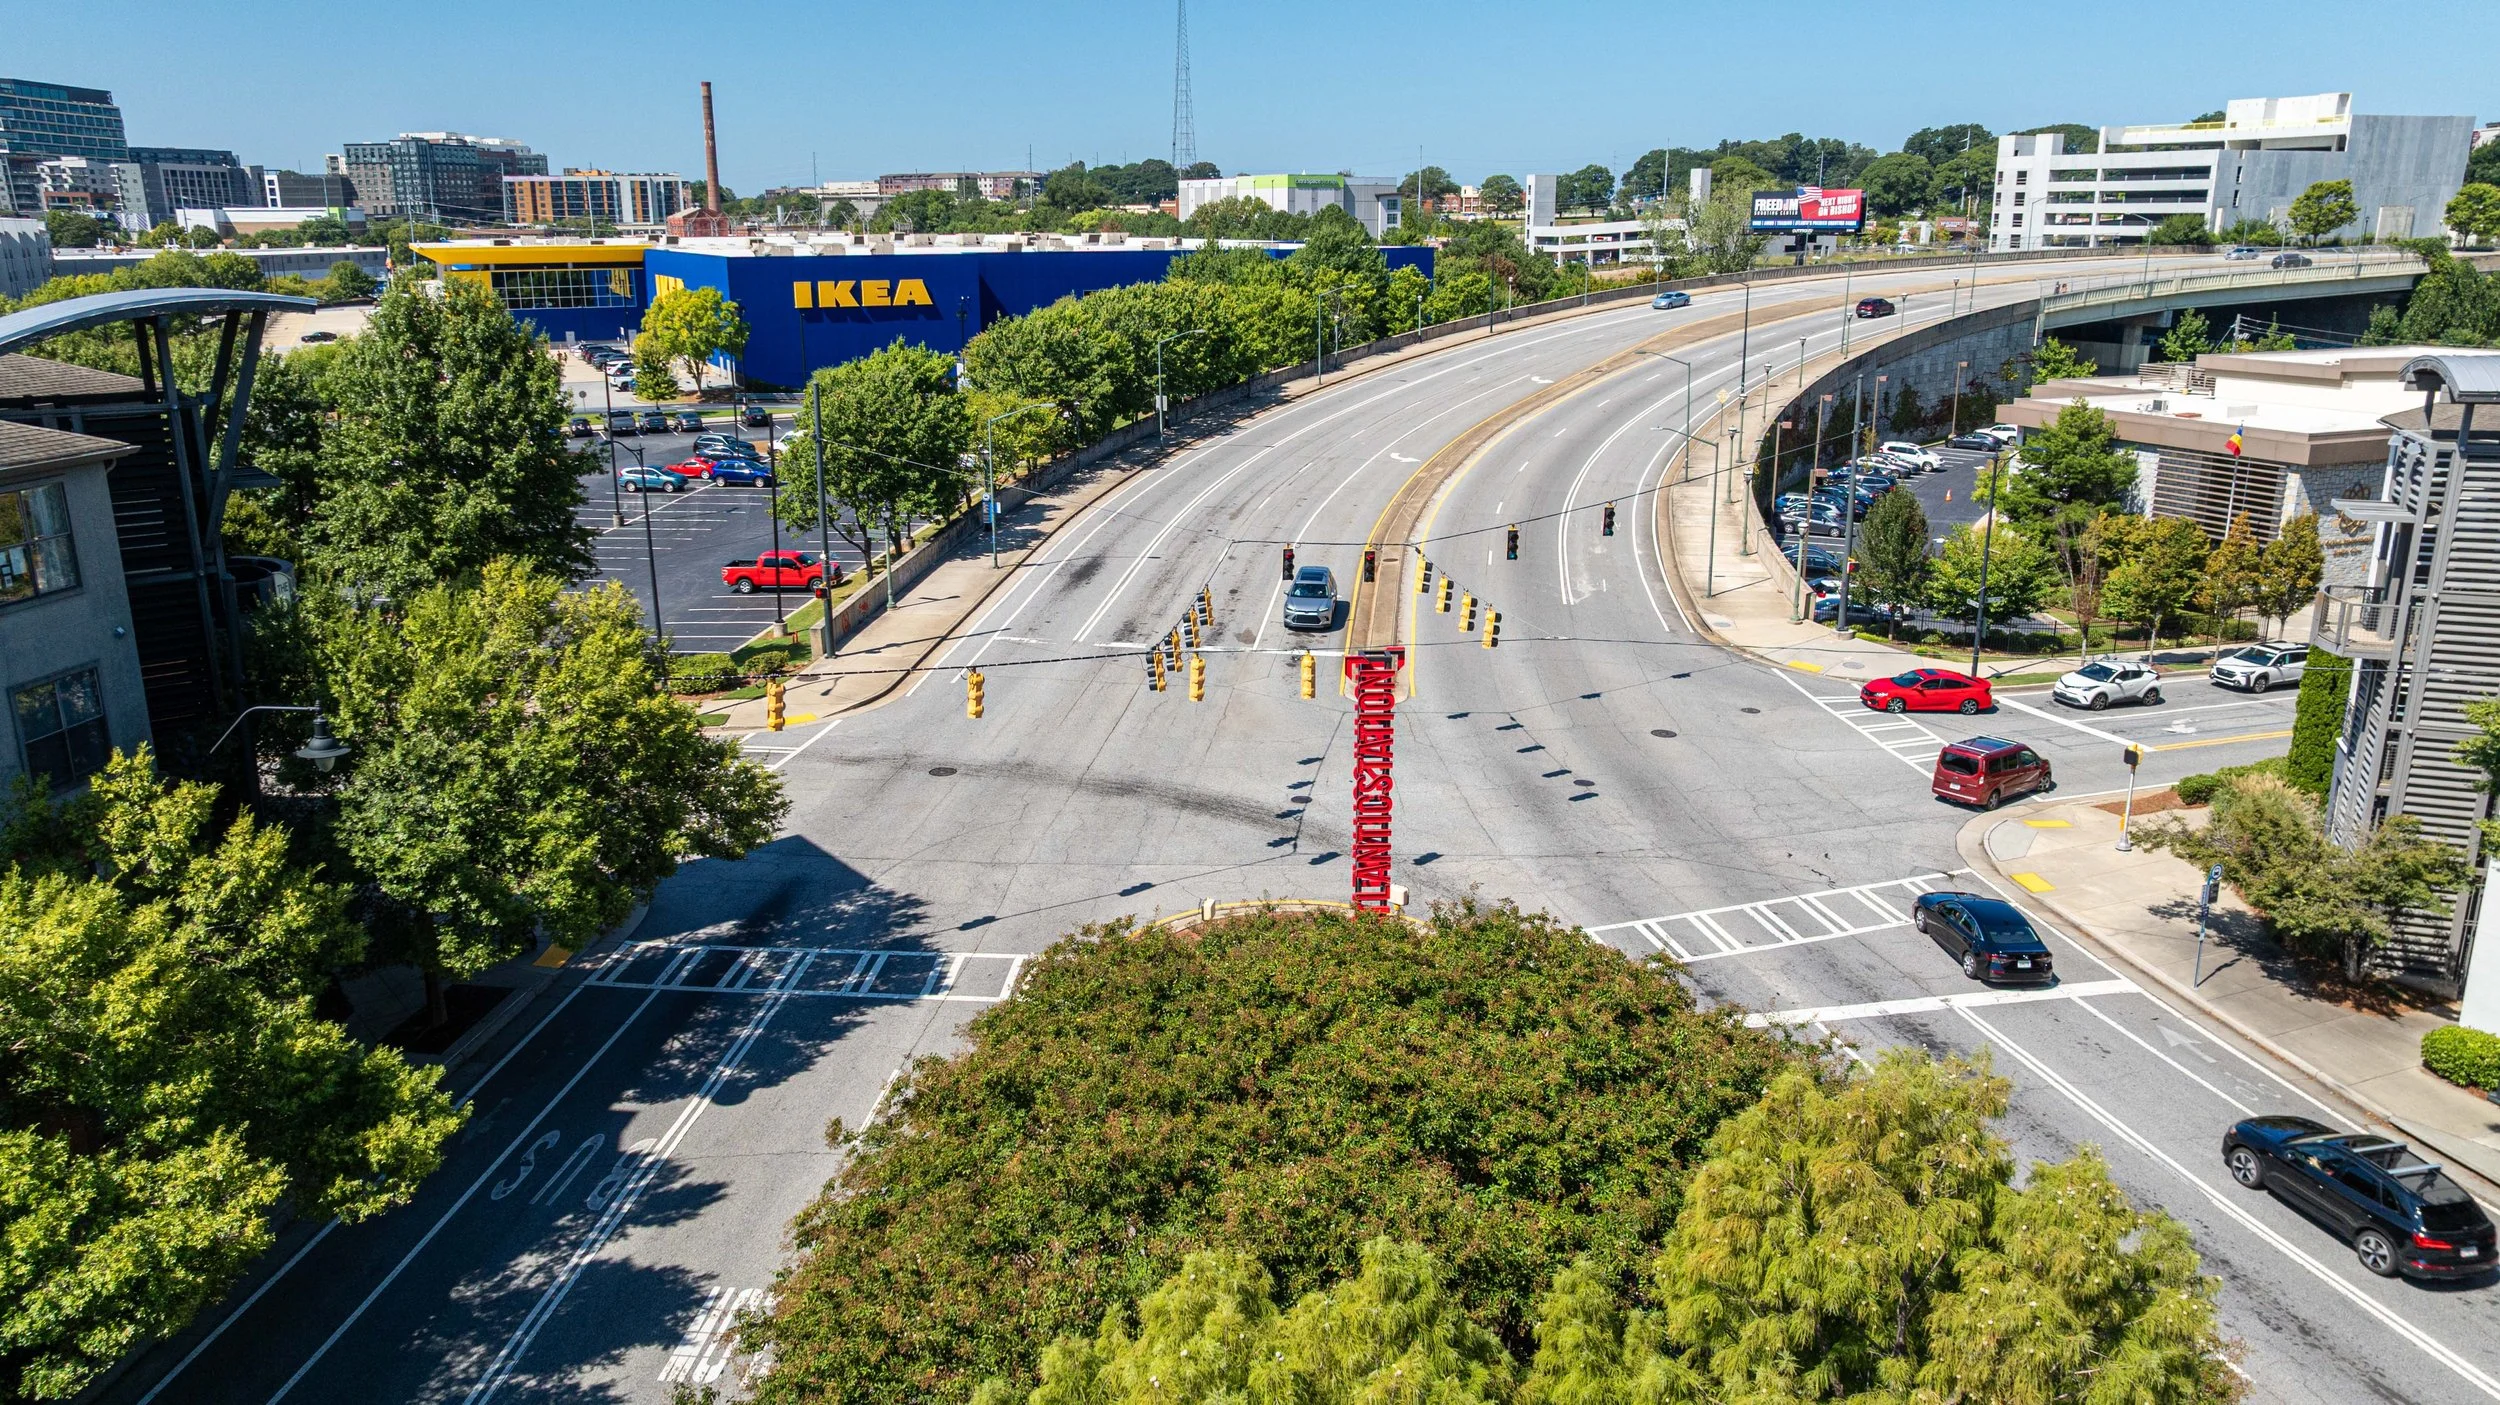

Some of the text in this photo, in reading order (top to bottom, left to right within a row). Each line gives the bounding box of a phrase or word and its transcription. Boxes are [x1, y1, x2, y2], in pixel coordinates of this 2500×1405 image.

[1818, 204, 1857, 217] ON BISHOP
[793, 278, 934, 309] IKEA
[277, 582, 289, 594] THE
[491, 1129, 658, 1211] BUS
